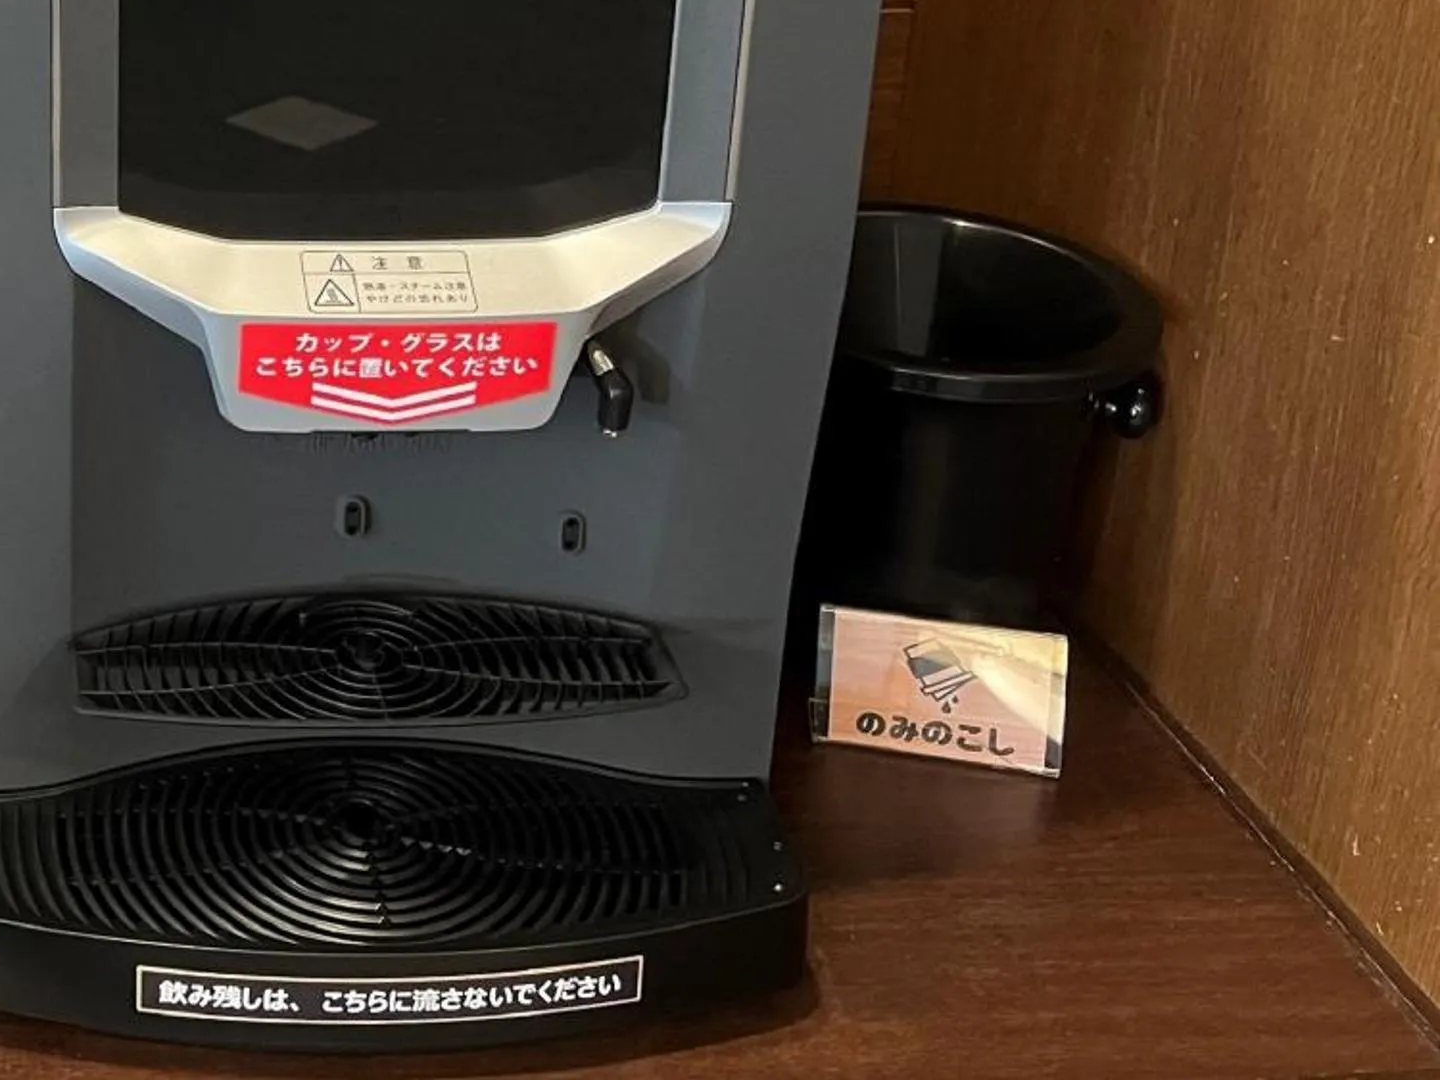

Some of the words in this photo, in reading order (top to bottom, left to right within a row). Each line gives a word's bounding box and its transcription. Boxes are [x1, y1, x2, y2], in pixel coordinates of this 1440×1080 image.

[372, 255, 423, 270] 注意
[295, 332, 502, 353] カップ・グラスは
[256, 357, 539, 379] こちらに置いてください
[856, 711, 1015, 757] のみのこし
